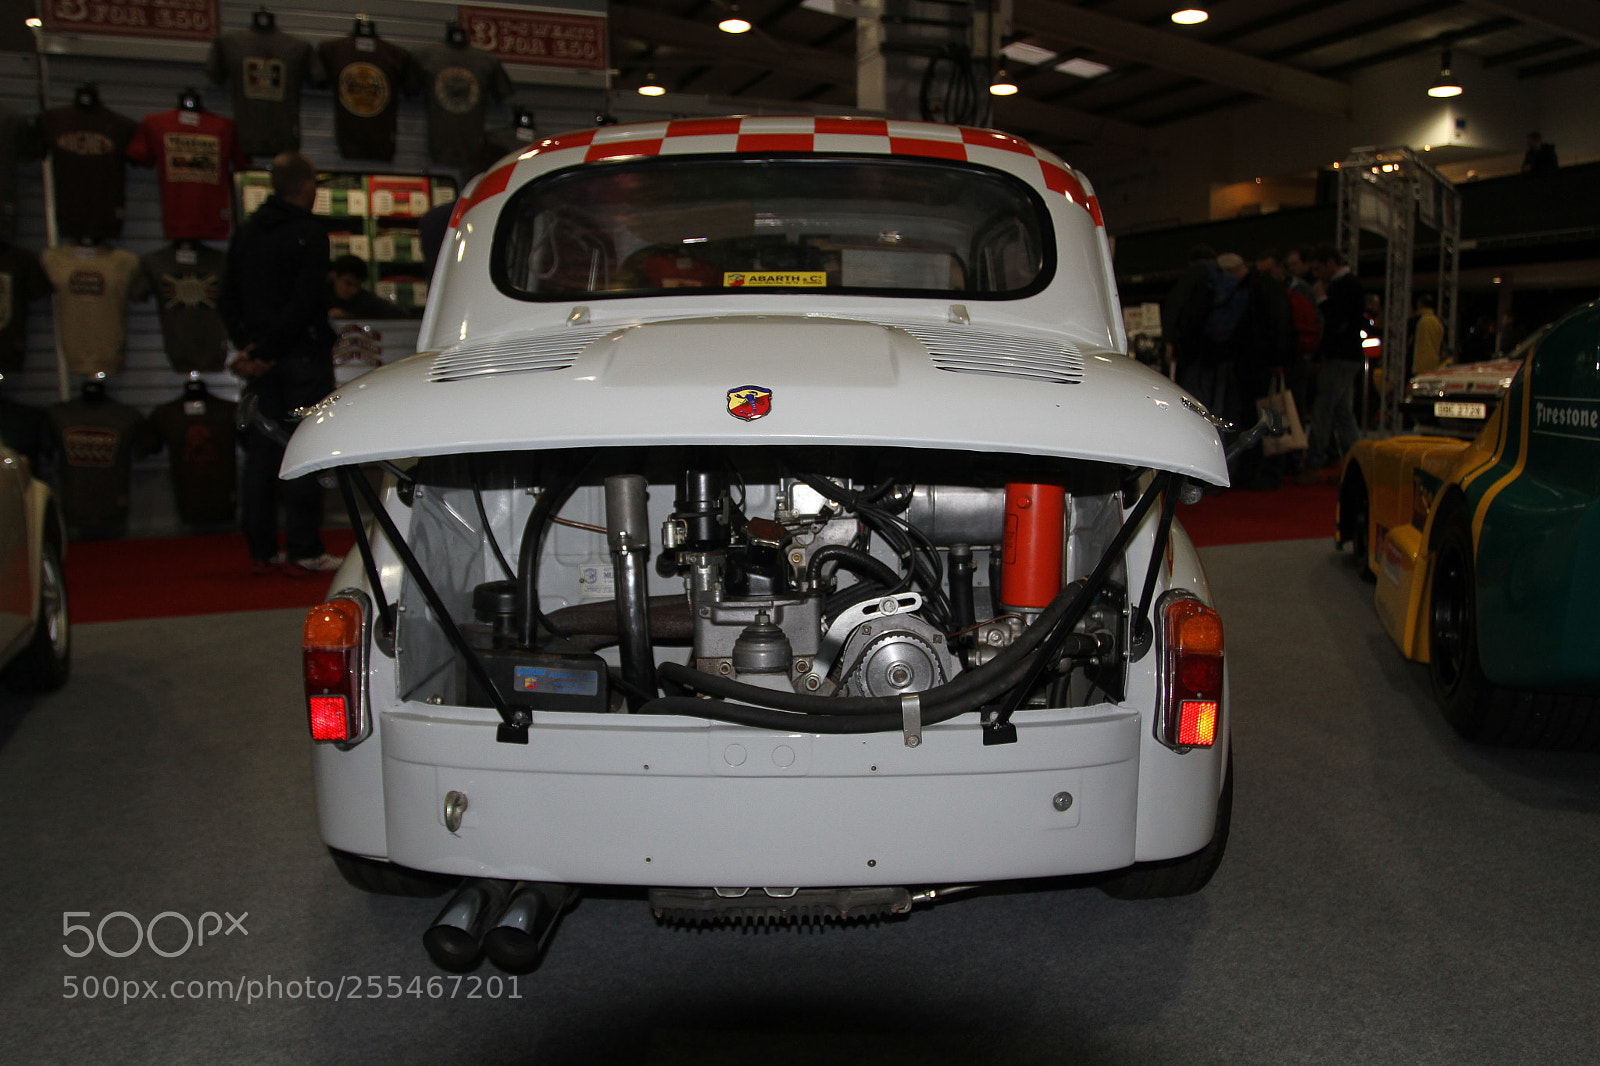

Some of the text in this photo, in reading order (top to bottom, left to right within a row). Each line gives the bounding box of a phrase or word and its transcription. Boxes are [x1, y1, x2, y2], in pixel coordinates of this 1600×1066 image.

[89, 3, 148, 25] FOR
[470, 18, 498, 50] 3
[498, 36, 547, 55] FOR
[1536, 402, 1600, 429] Firestone
